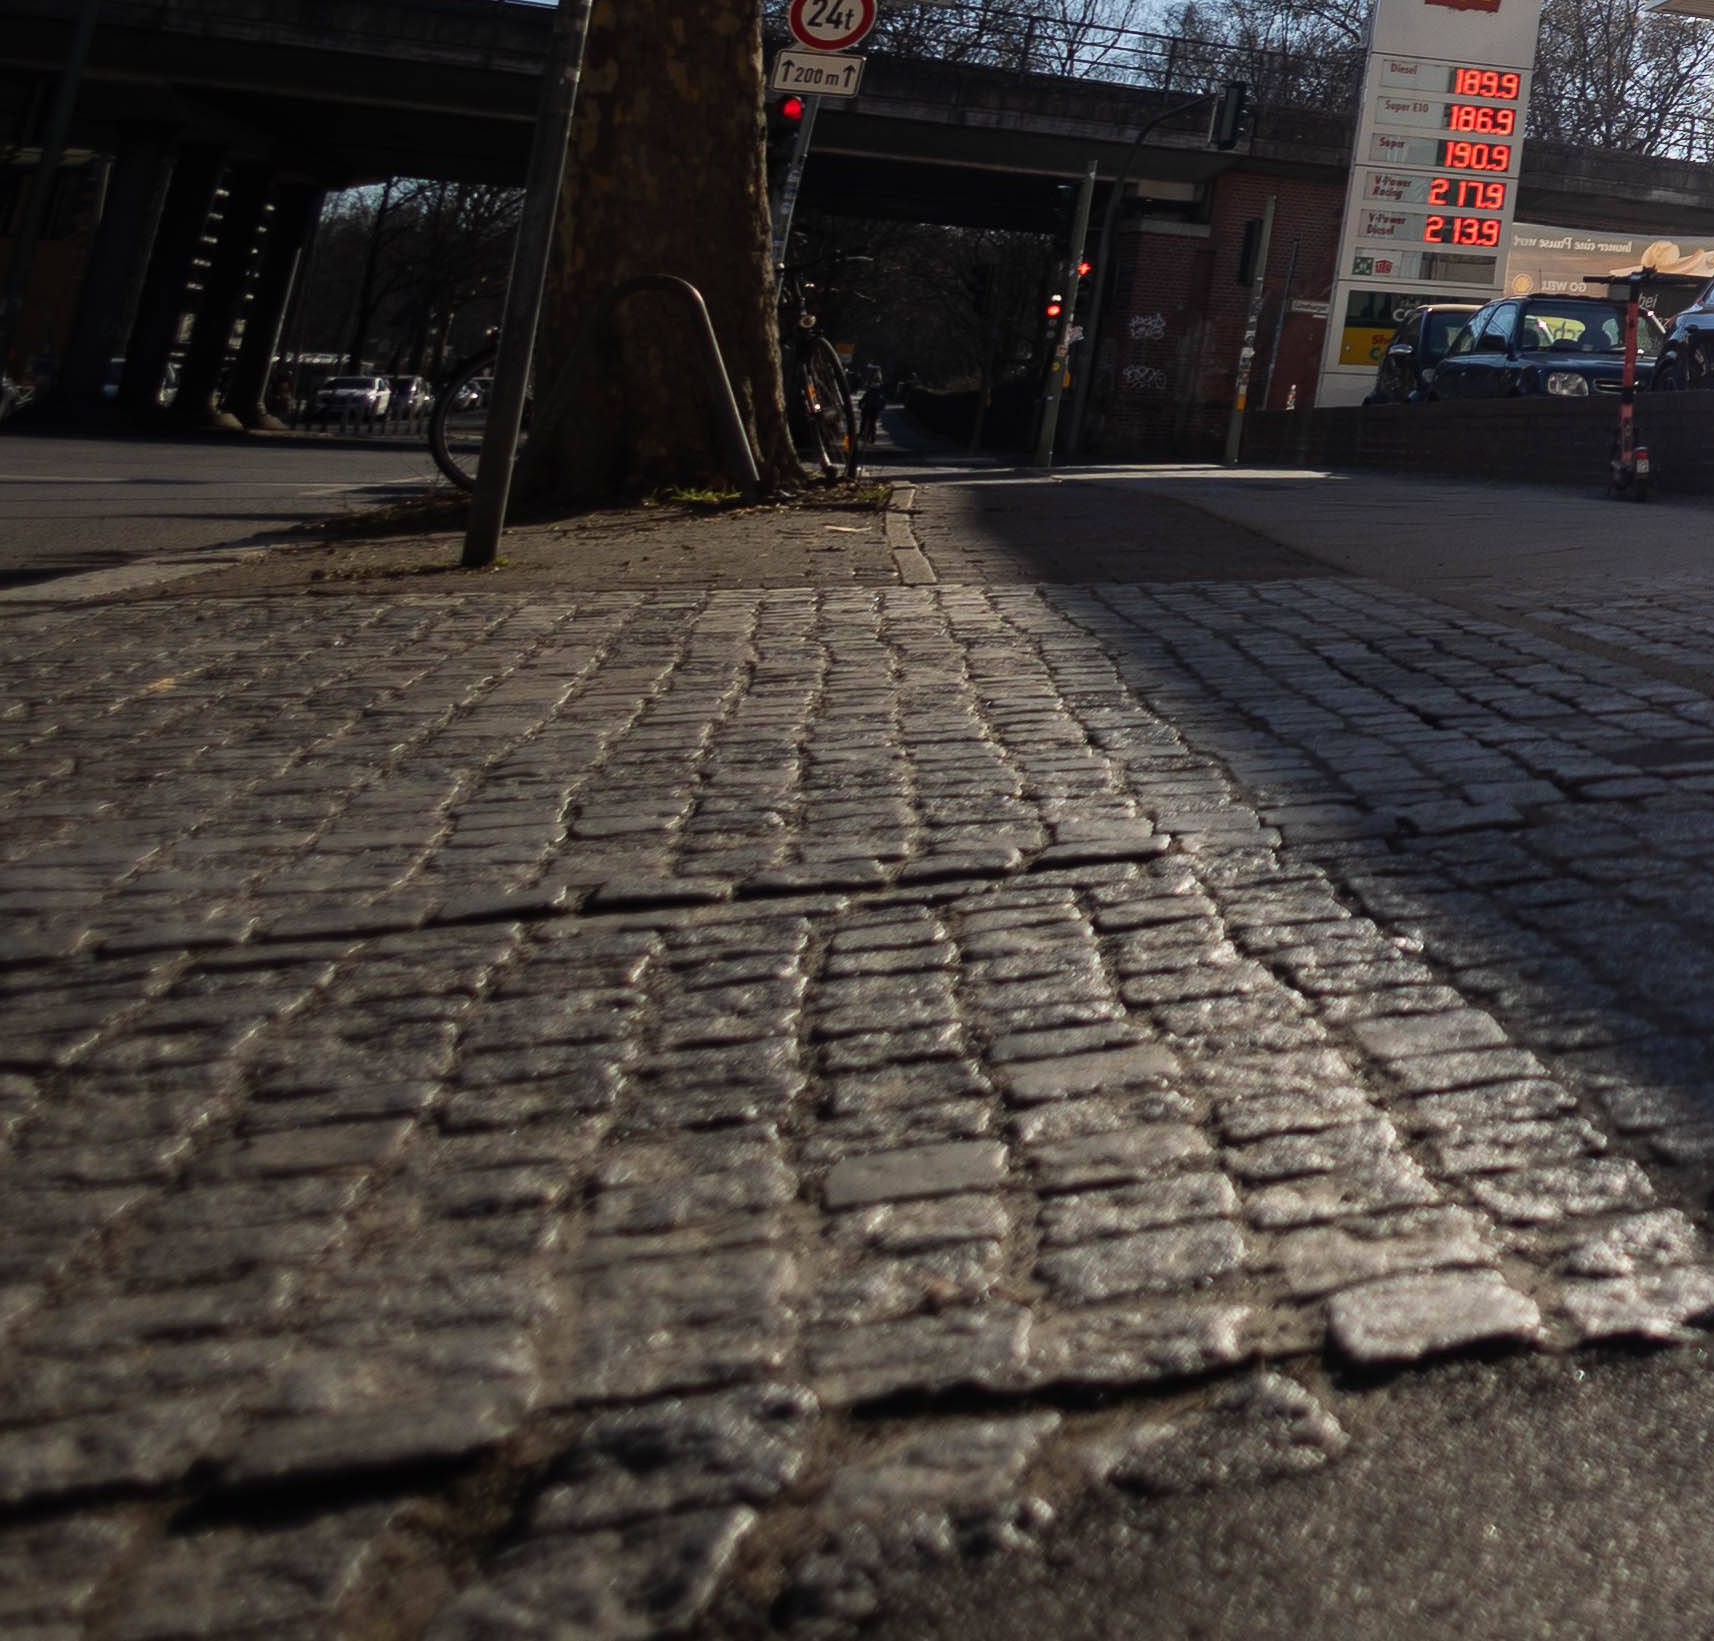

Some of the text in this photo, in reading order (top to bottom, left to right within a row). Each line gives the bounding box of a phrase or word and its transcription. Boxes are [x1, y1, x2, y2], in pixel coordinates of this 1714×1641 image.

[1390, 62, 1418, 75] Diesel
[793, 67, 840, 86] 200 m
[1384, 99, 1410, 113] Super
[1413, 102, 1429, 114] E10
[1379, 136, 1405, 150] Super
[1374, 175, 1413, 188] V-Power
